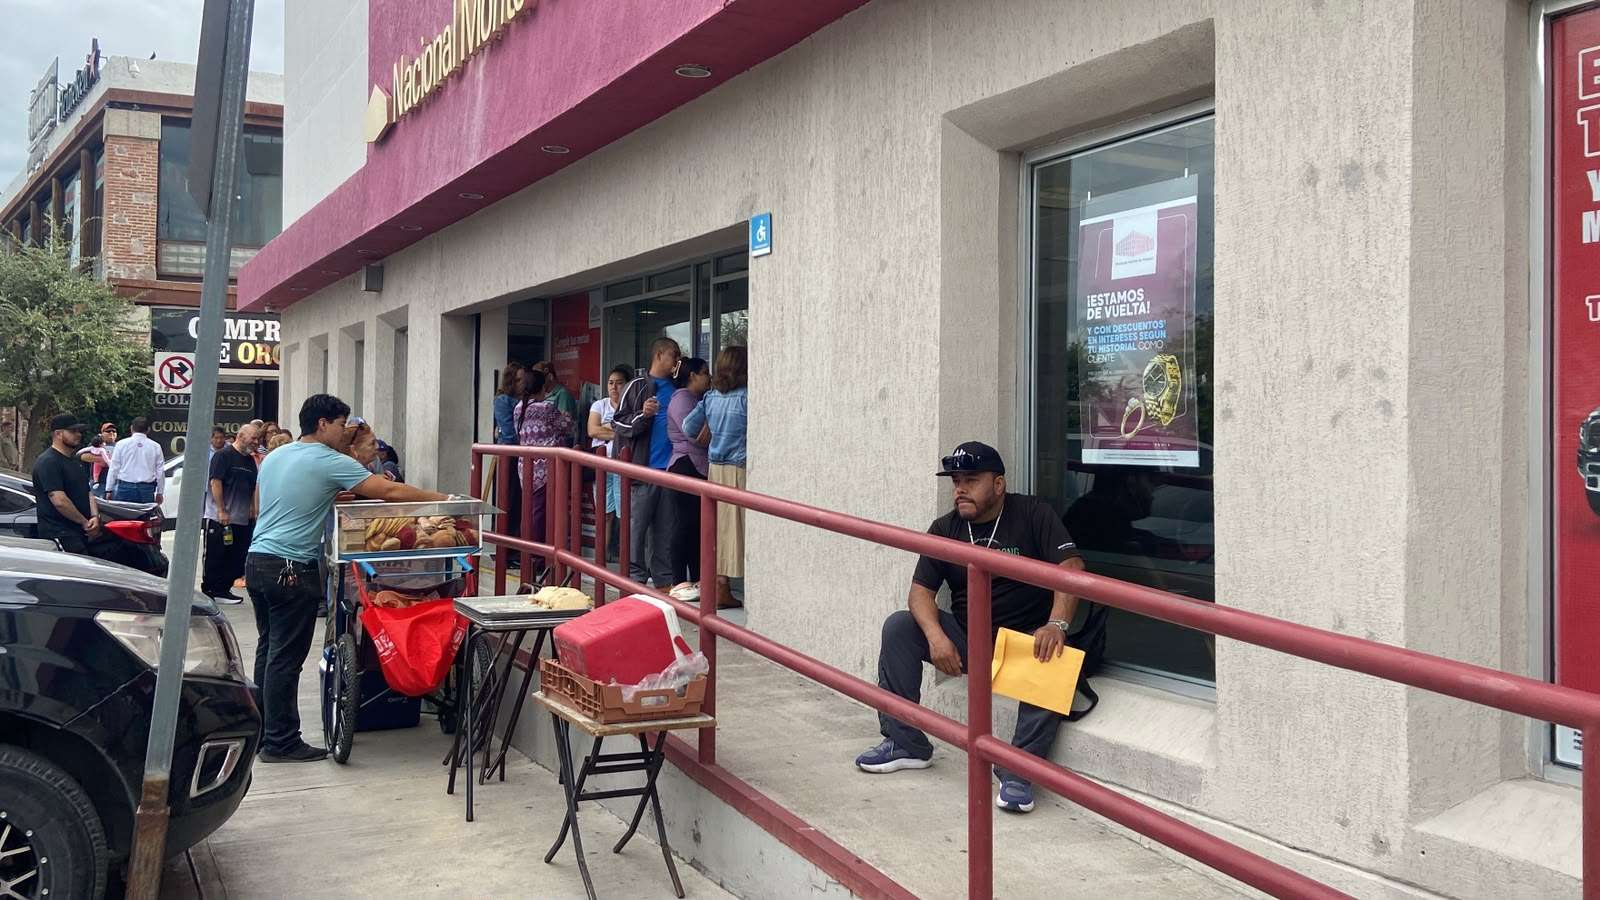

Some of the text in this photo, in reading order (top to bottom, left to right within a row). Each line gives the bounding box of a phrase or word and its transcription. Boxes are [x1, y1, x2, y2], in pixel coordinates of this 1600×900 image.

[393, 0, 456, 123] Nacional
[1087, 288, 1144, 307] ¡ESTAMOS
[1087, 301, 1150, 320] DE VUELTA!
[1087, 327, 1093, 335] Y
[1094, 325, 1112, 335] CON
[1088, 336, 1097, 345] EN
[1098, 332, 1138, 344] INTERESES
[1088, 340, 1164, 354] TU HISTORIAL COMO
